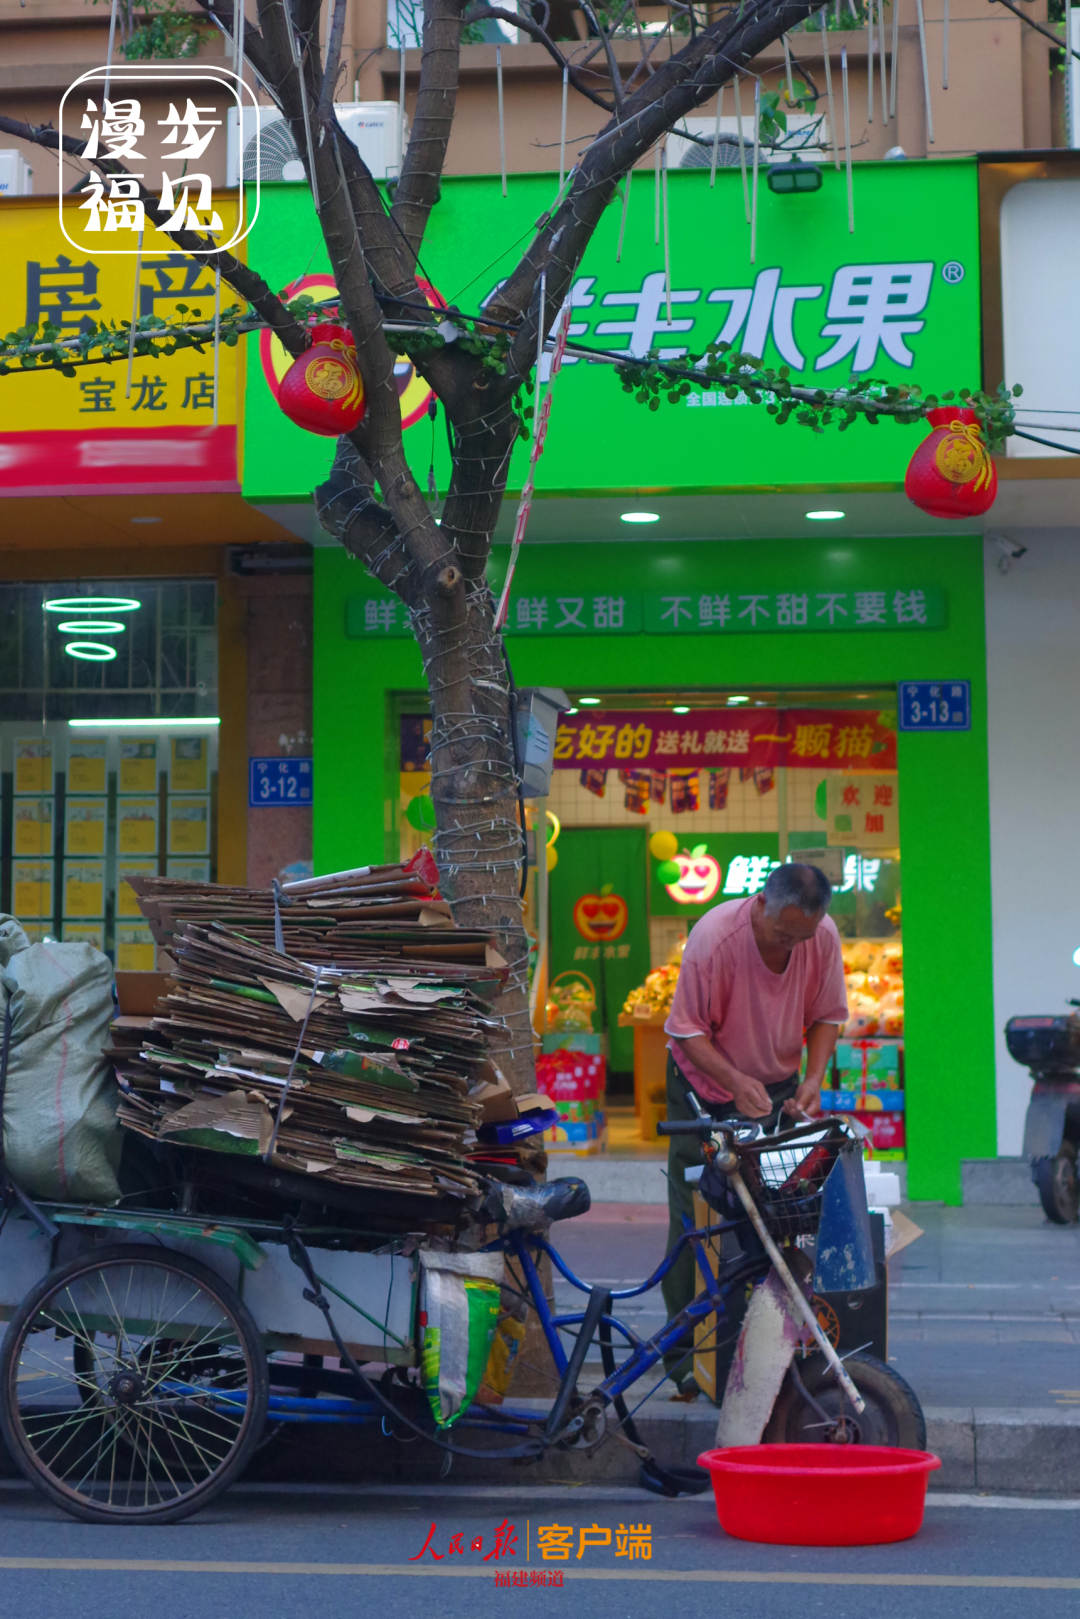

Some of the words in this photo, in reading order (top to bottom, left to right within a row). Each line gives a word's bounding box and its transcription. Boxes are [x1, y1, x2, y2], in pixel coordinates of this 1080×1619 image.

[26, 250, 216, 340] 房产
[79, 372, 215, 413] 宝龙店
[660, 590, 927, 628] 不鲜不甜不要钱
